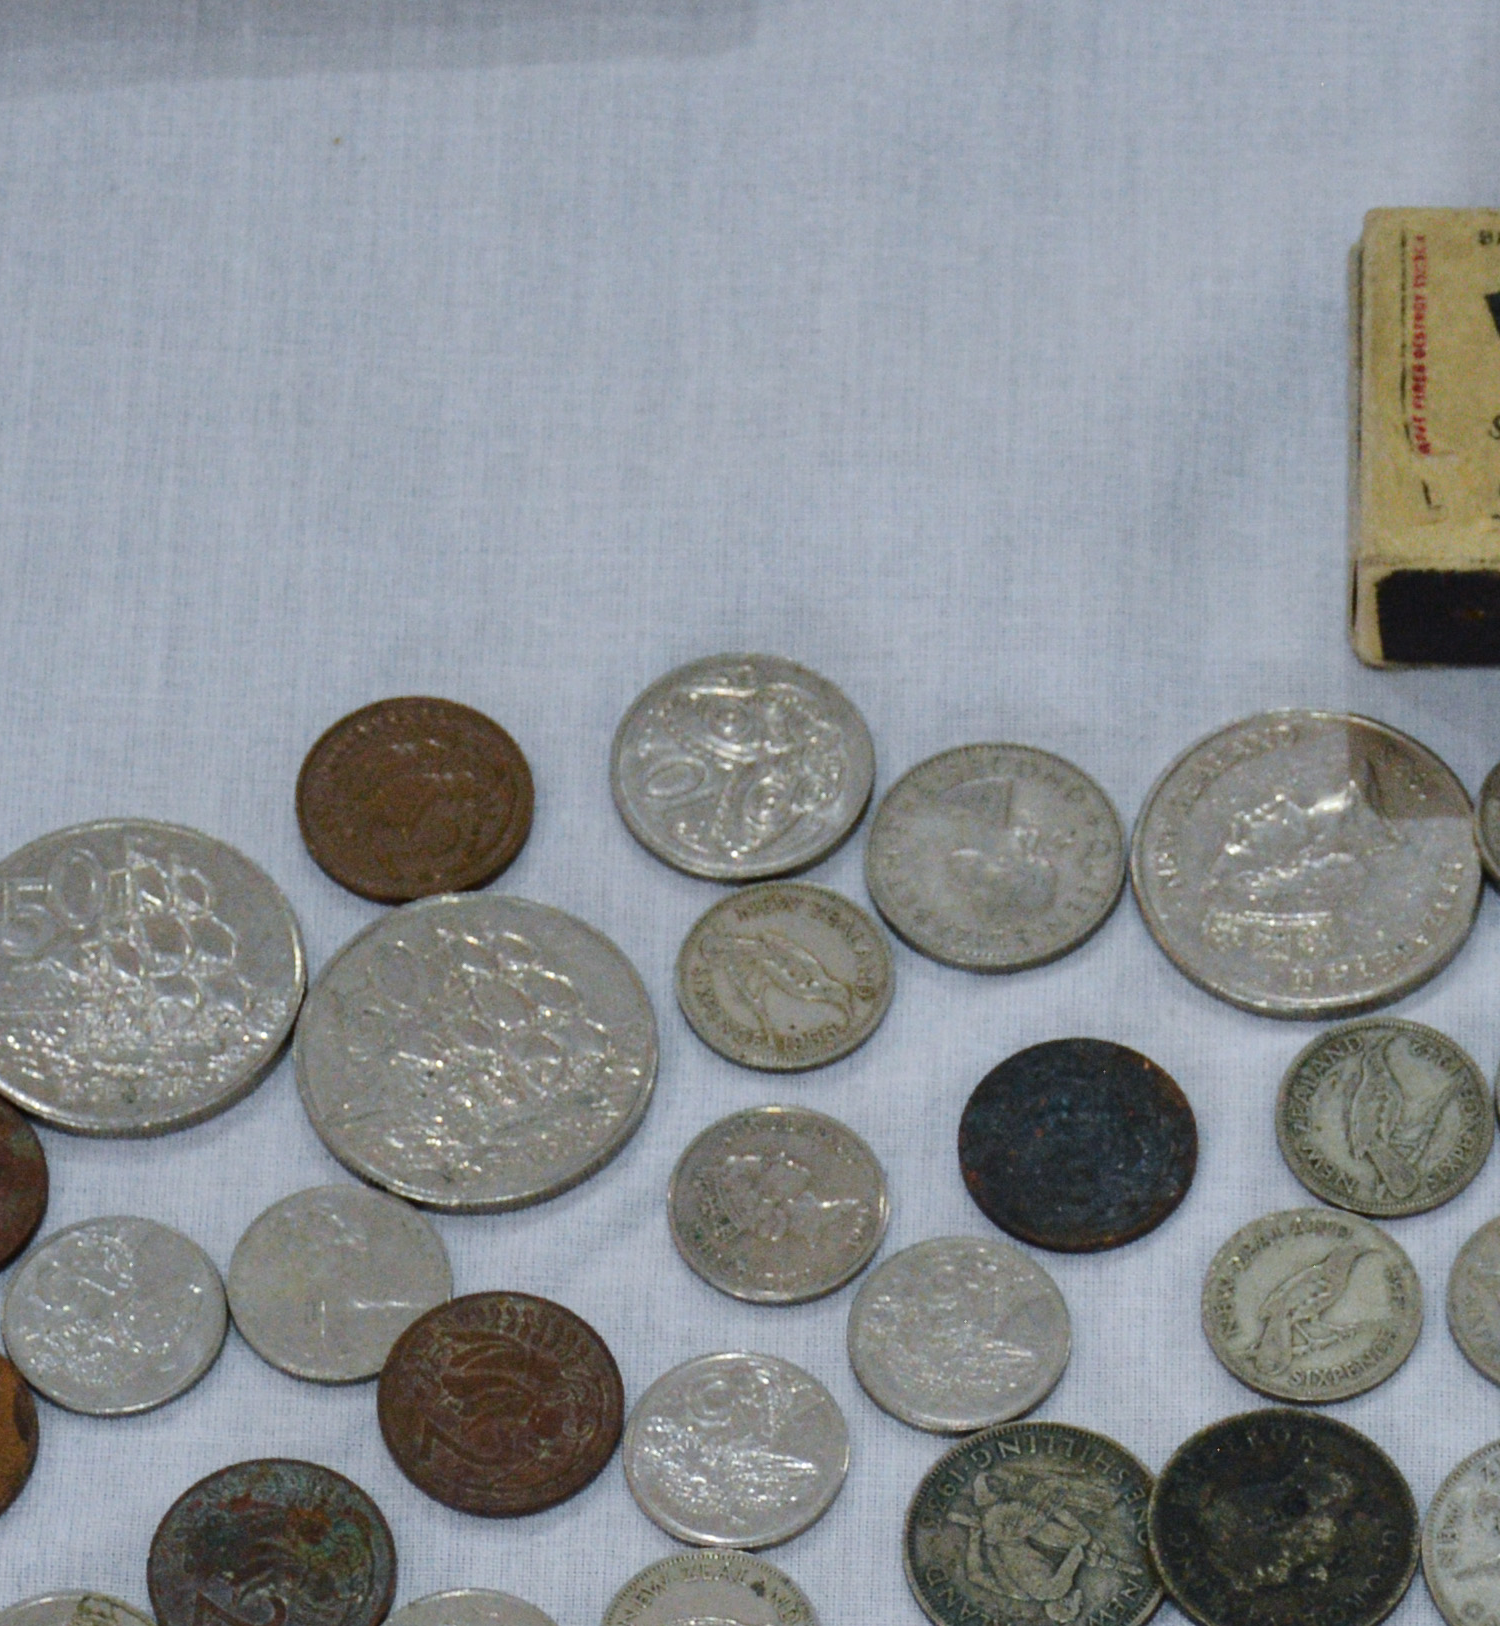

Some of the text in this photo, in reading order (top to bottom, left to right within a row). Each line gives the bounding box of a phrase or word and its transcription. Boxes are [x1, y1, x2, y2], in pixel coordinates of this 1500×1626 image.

[0, 845, 98, 958] 50
[1295, 1034, 1366, 1202] NEW ZEALAND
